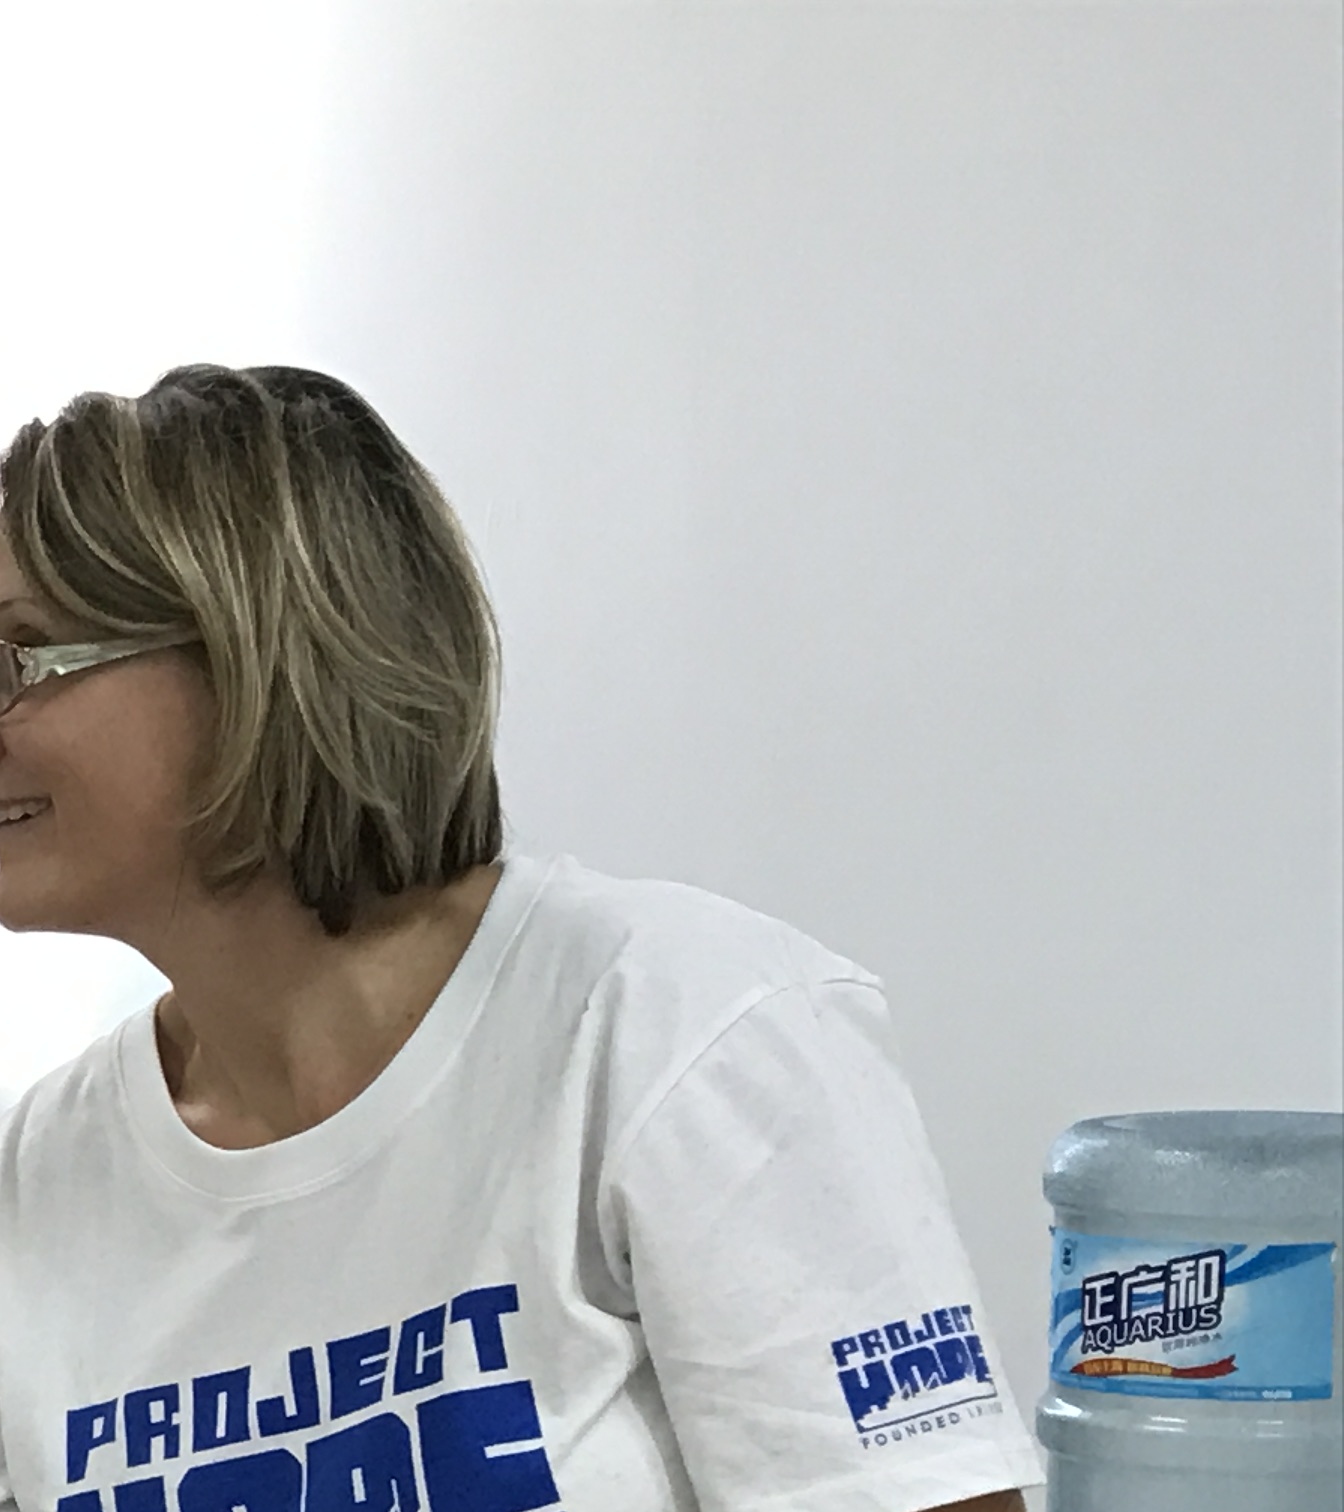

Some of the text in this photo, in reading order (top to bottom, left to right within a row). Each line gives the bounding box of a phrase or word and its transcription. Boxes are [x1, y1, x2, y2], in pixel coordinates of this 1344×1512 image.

[831, 1304, 974, 1367] PROJECT
[1085, 1304, 1217, 1350] AQUARIUS
[67, 1284, 519, 1484] PROJECT
[838, 1335, 996, 1430] HOPE
[861, 1412, 961, 1450] FOUNDED
